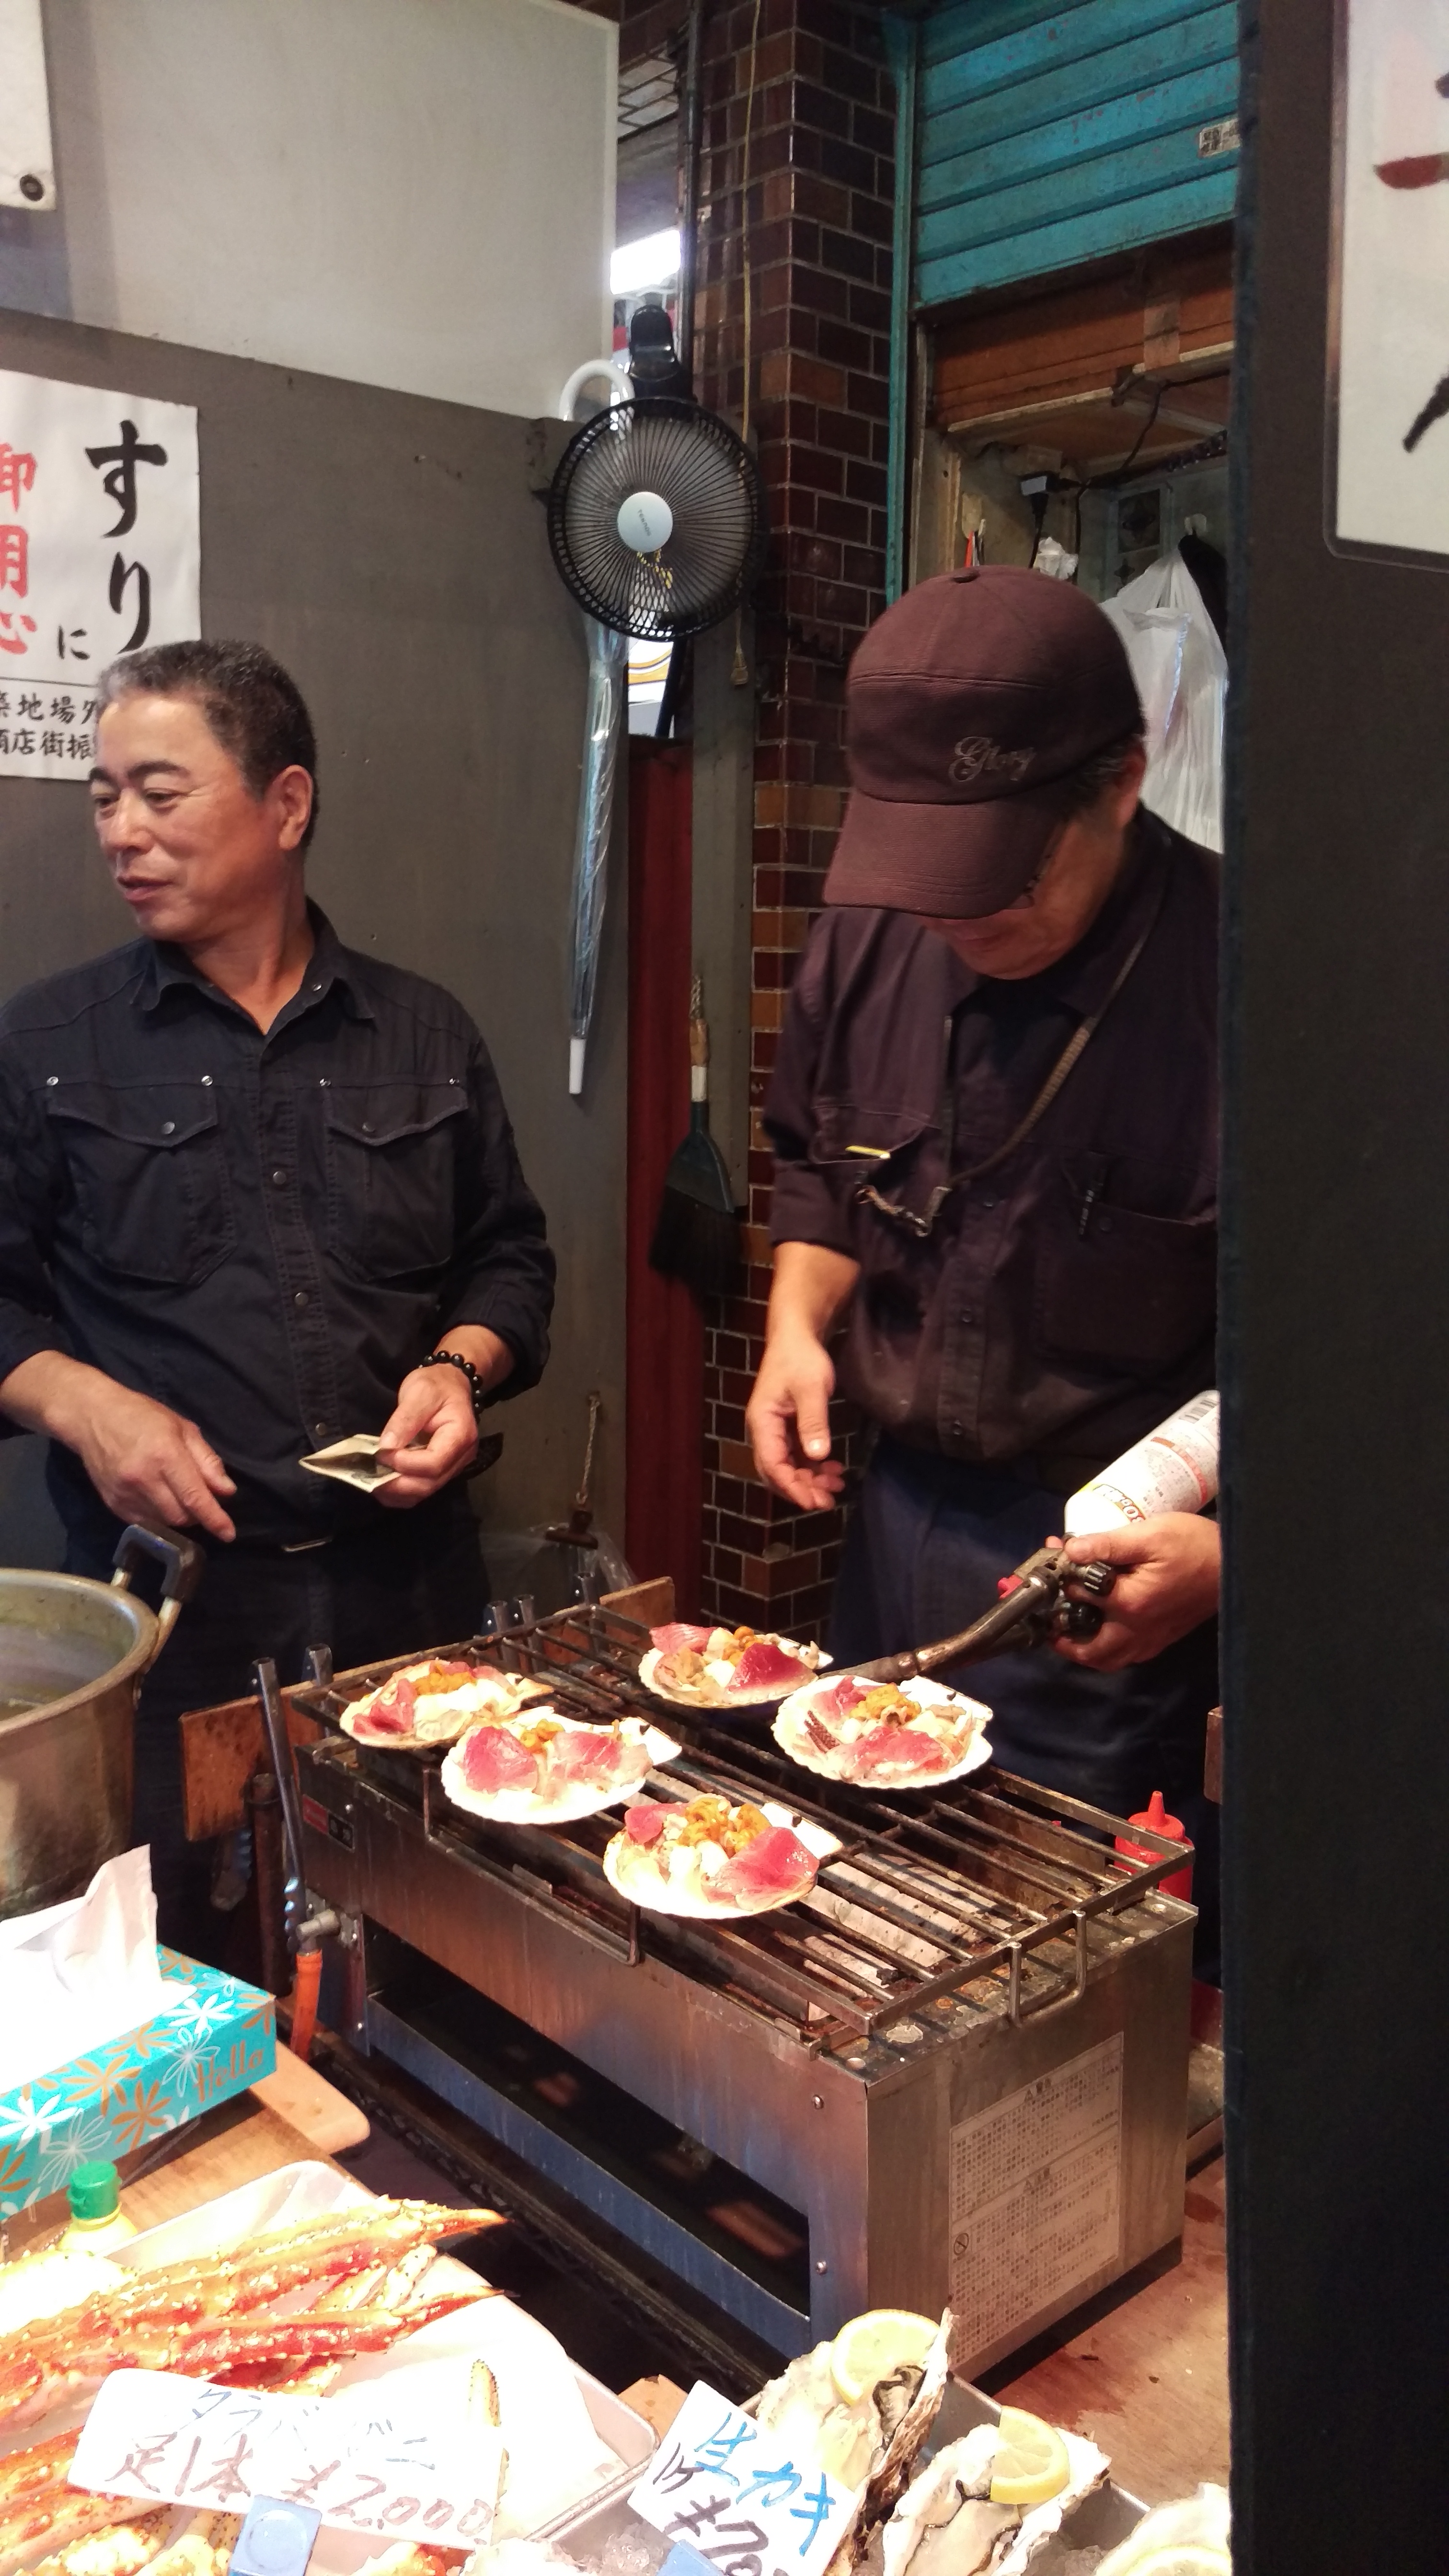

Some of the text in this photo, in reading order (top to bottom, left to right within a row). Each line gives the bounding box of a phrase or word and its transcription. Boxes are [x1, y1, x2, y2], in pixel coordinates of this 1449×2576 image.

[85, 420, 168, 654] すり
[57, 625, 90, 660] に
[664, 2495, 788, 2576] ¥70
